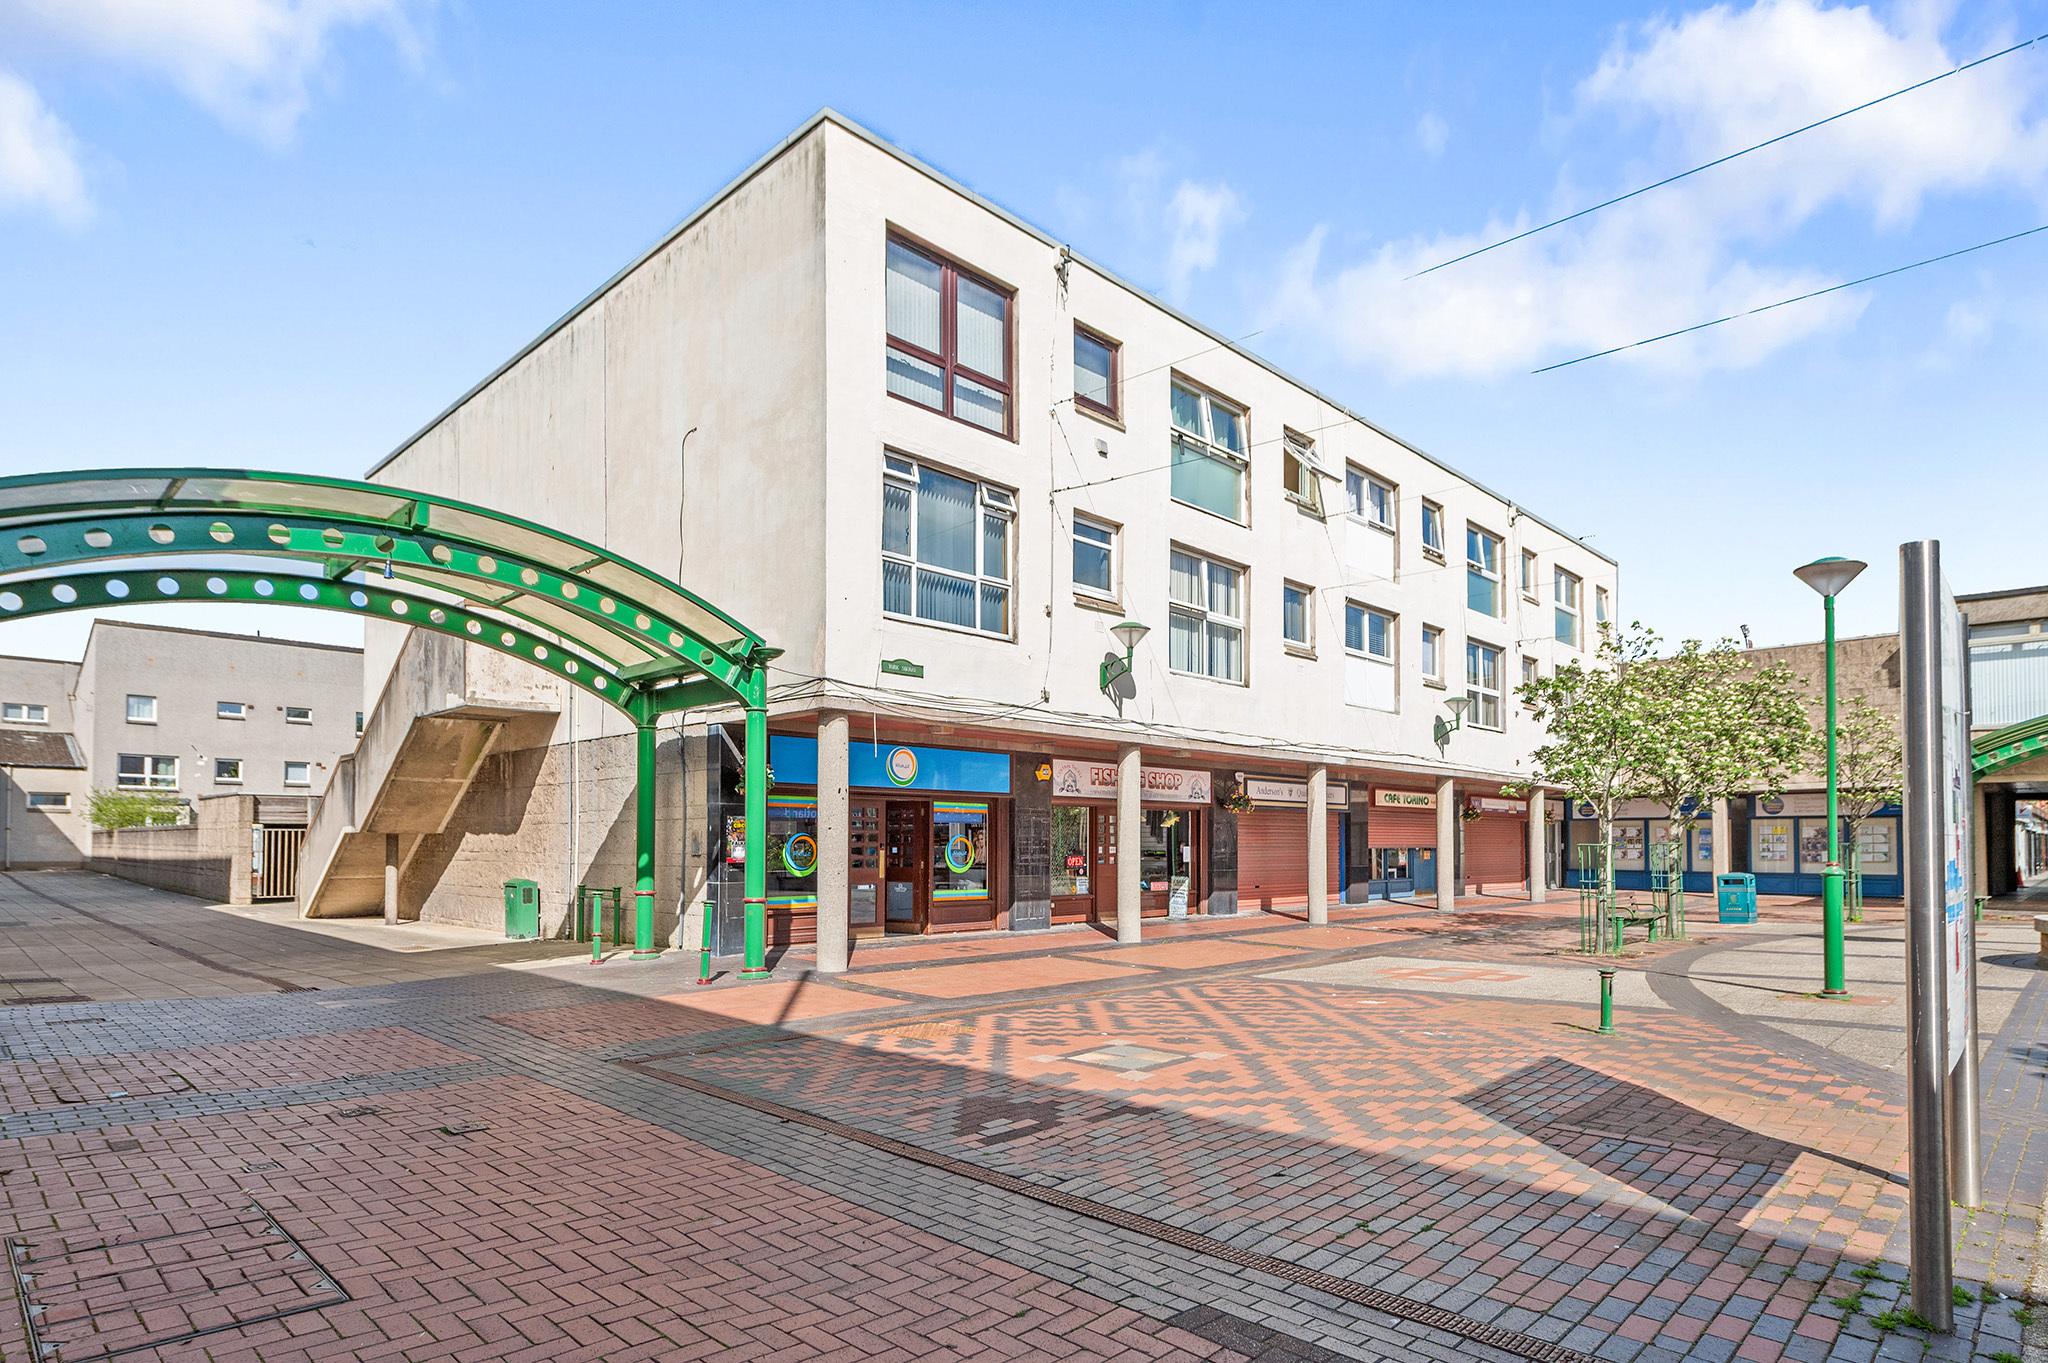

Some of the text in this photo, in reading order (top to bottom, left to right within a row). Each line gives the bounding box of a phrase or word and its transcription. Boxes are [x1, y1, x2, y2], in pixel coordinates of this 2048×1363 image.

[1090, 766, 1183, 790] FISHG SHOP
[1255, 786, 1284, 796] Anderson's
[1402, 794, 1430, 806] TORINO
[1067, 856, 1083, 866] OPEN
